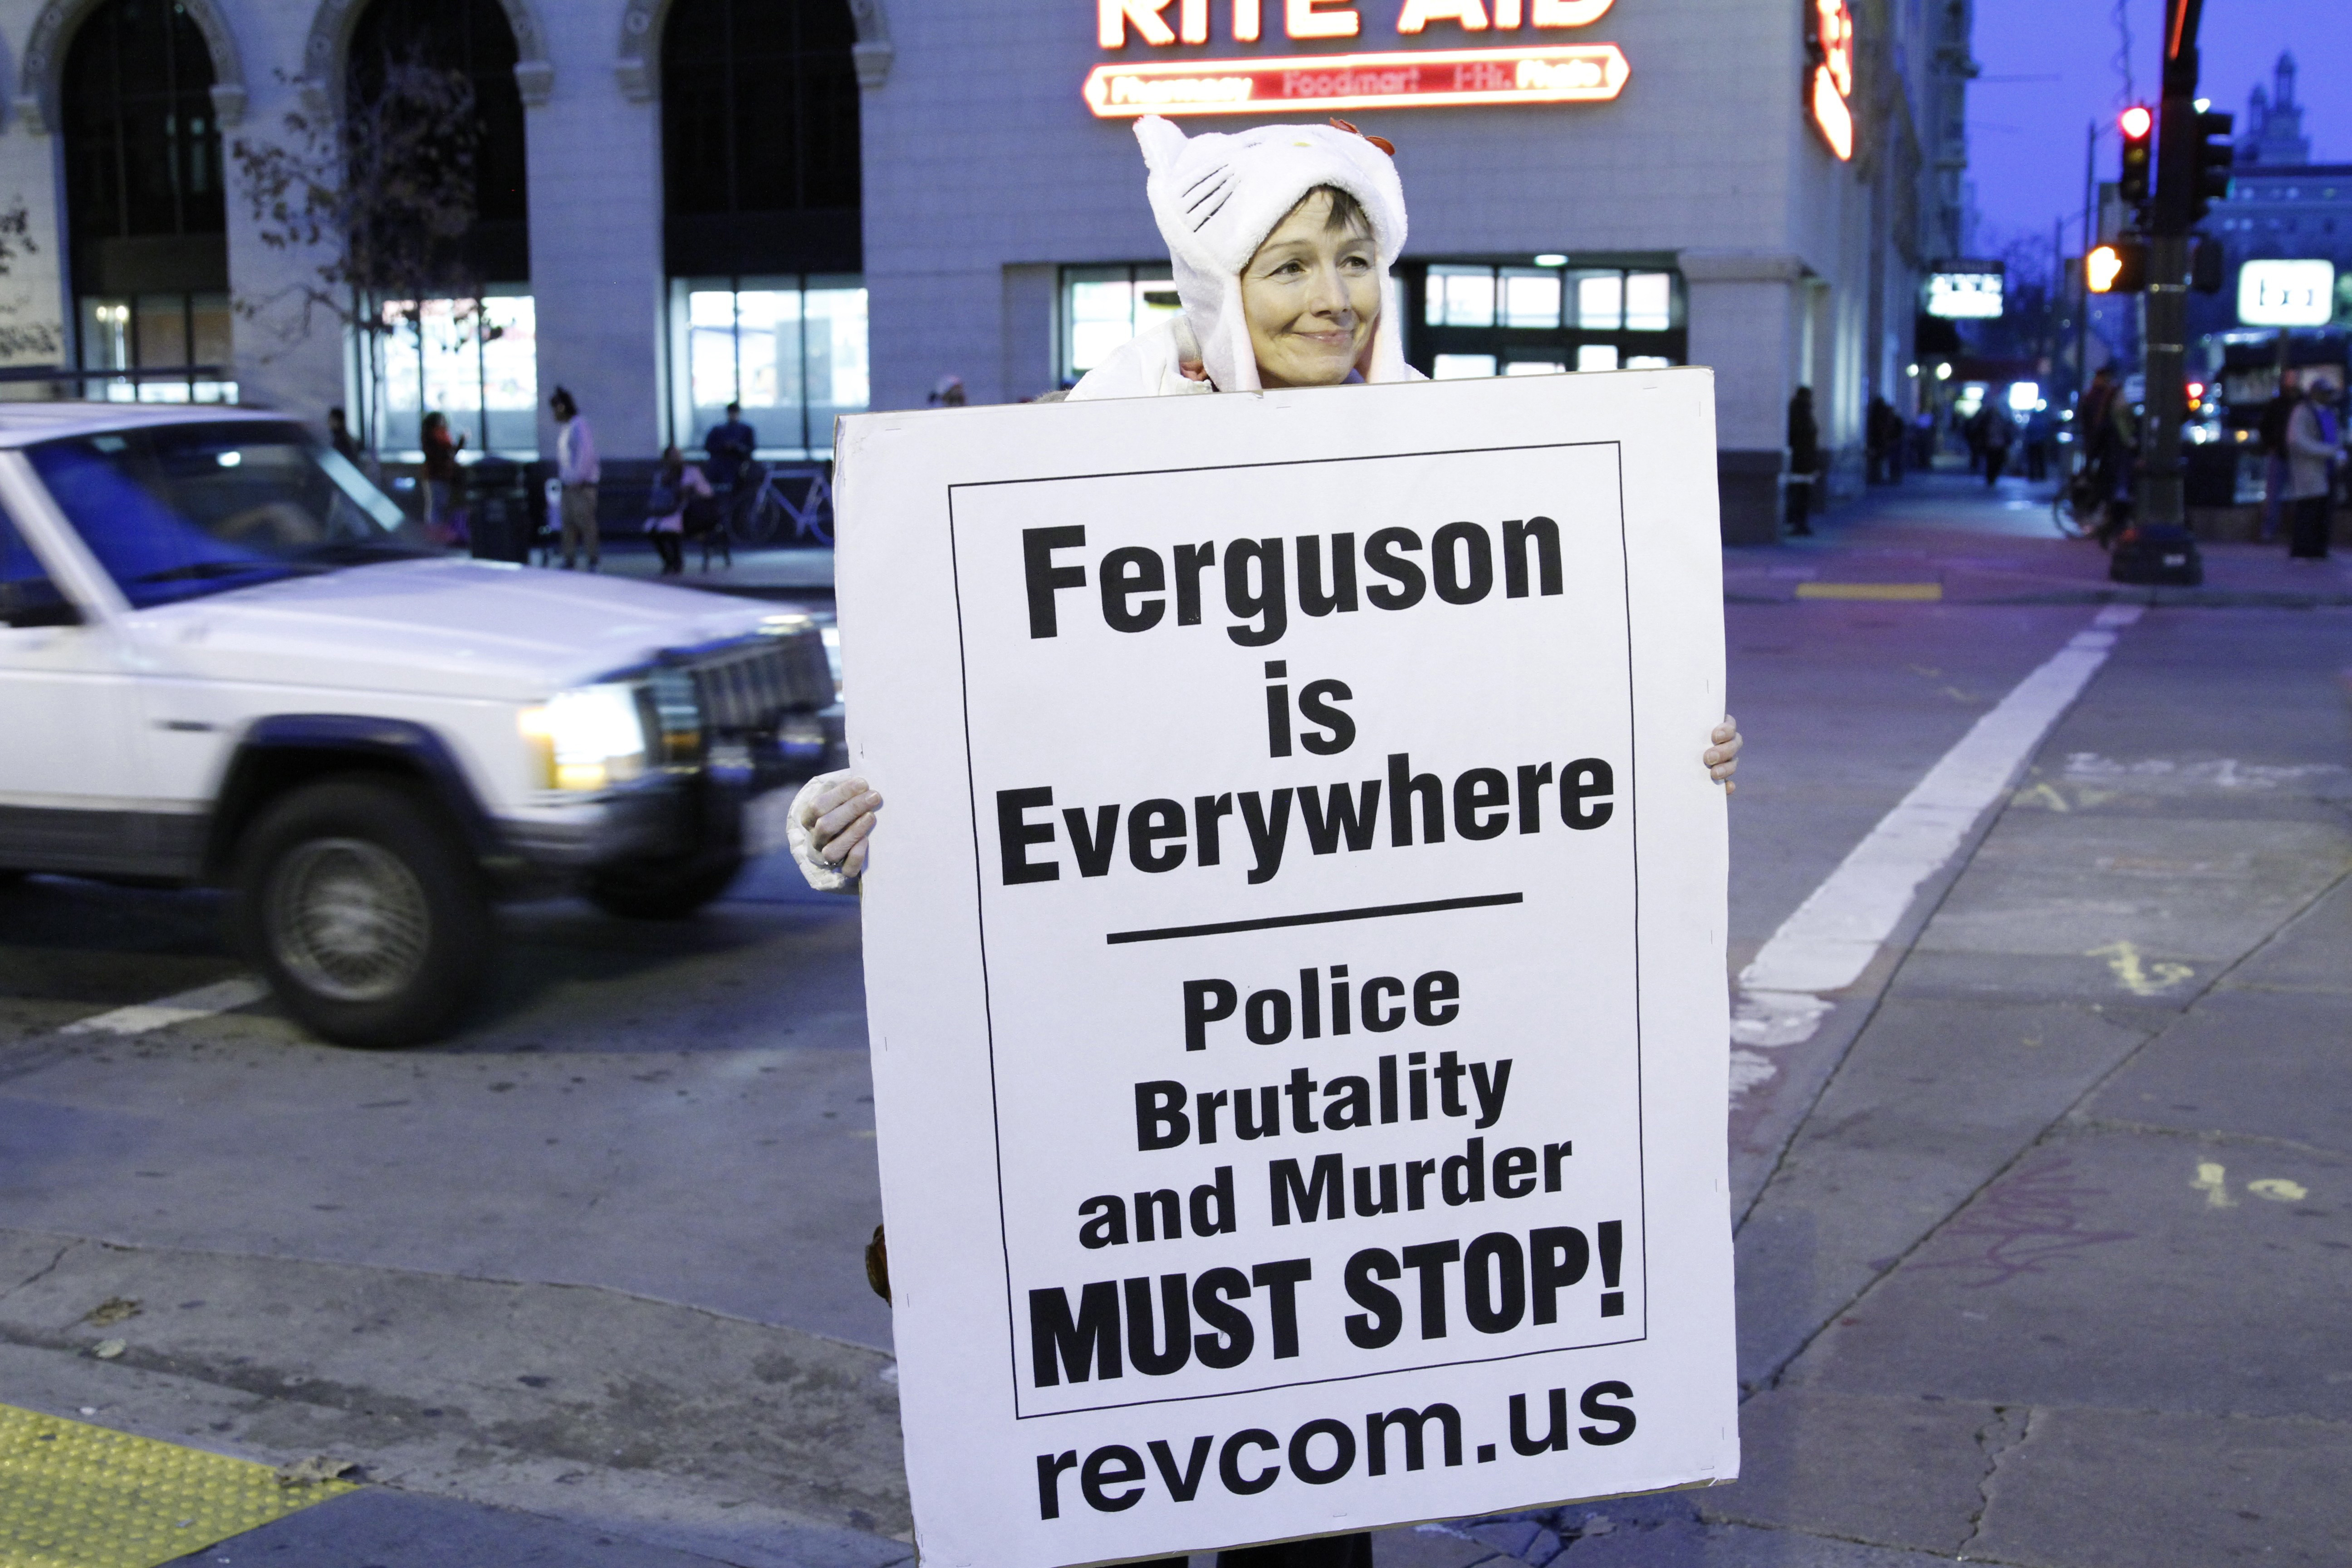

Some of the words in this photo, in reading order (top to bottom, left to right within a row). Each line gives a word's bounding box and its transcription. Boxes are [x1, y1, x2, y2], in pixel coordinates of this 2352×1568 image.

[1022, 516, 1563, 647] Ferguson
[1264, 659, 1356, 758] is
[996, 752, 1614, 886] Everywhere
[1182, 964, 1460, 1052] Police
[1134, 1050, 1513, 1152] Brutality
[1078, 1165, 1237, 1250] and
[1269, 1136, 1573, 1227] Murder
[1028, 1257, 1312, 1388] MUST
[1343, 1219, 1624, 1350] STOP!
[1036, 1380, 1637, 1521] revcom.us
